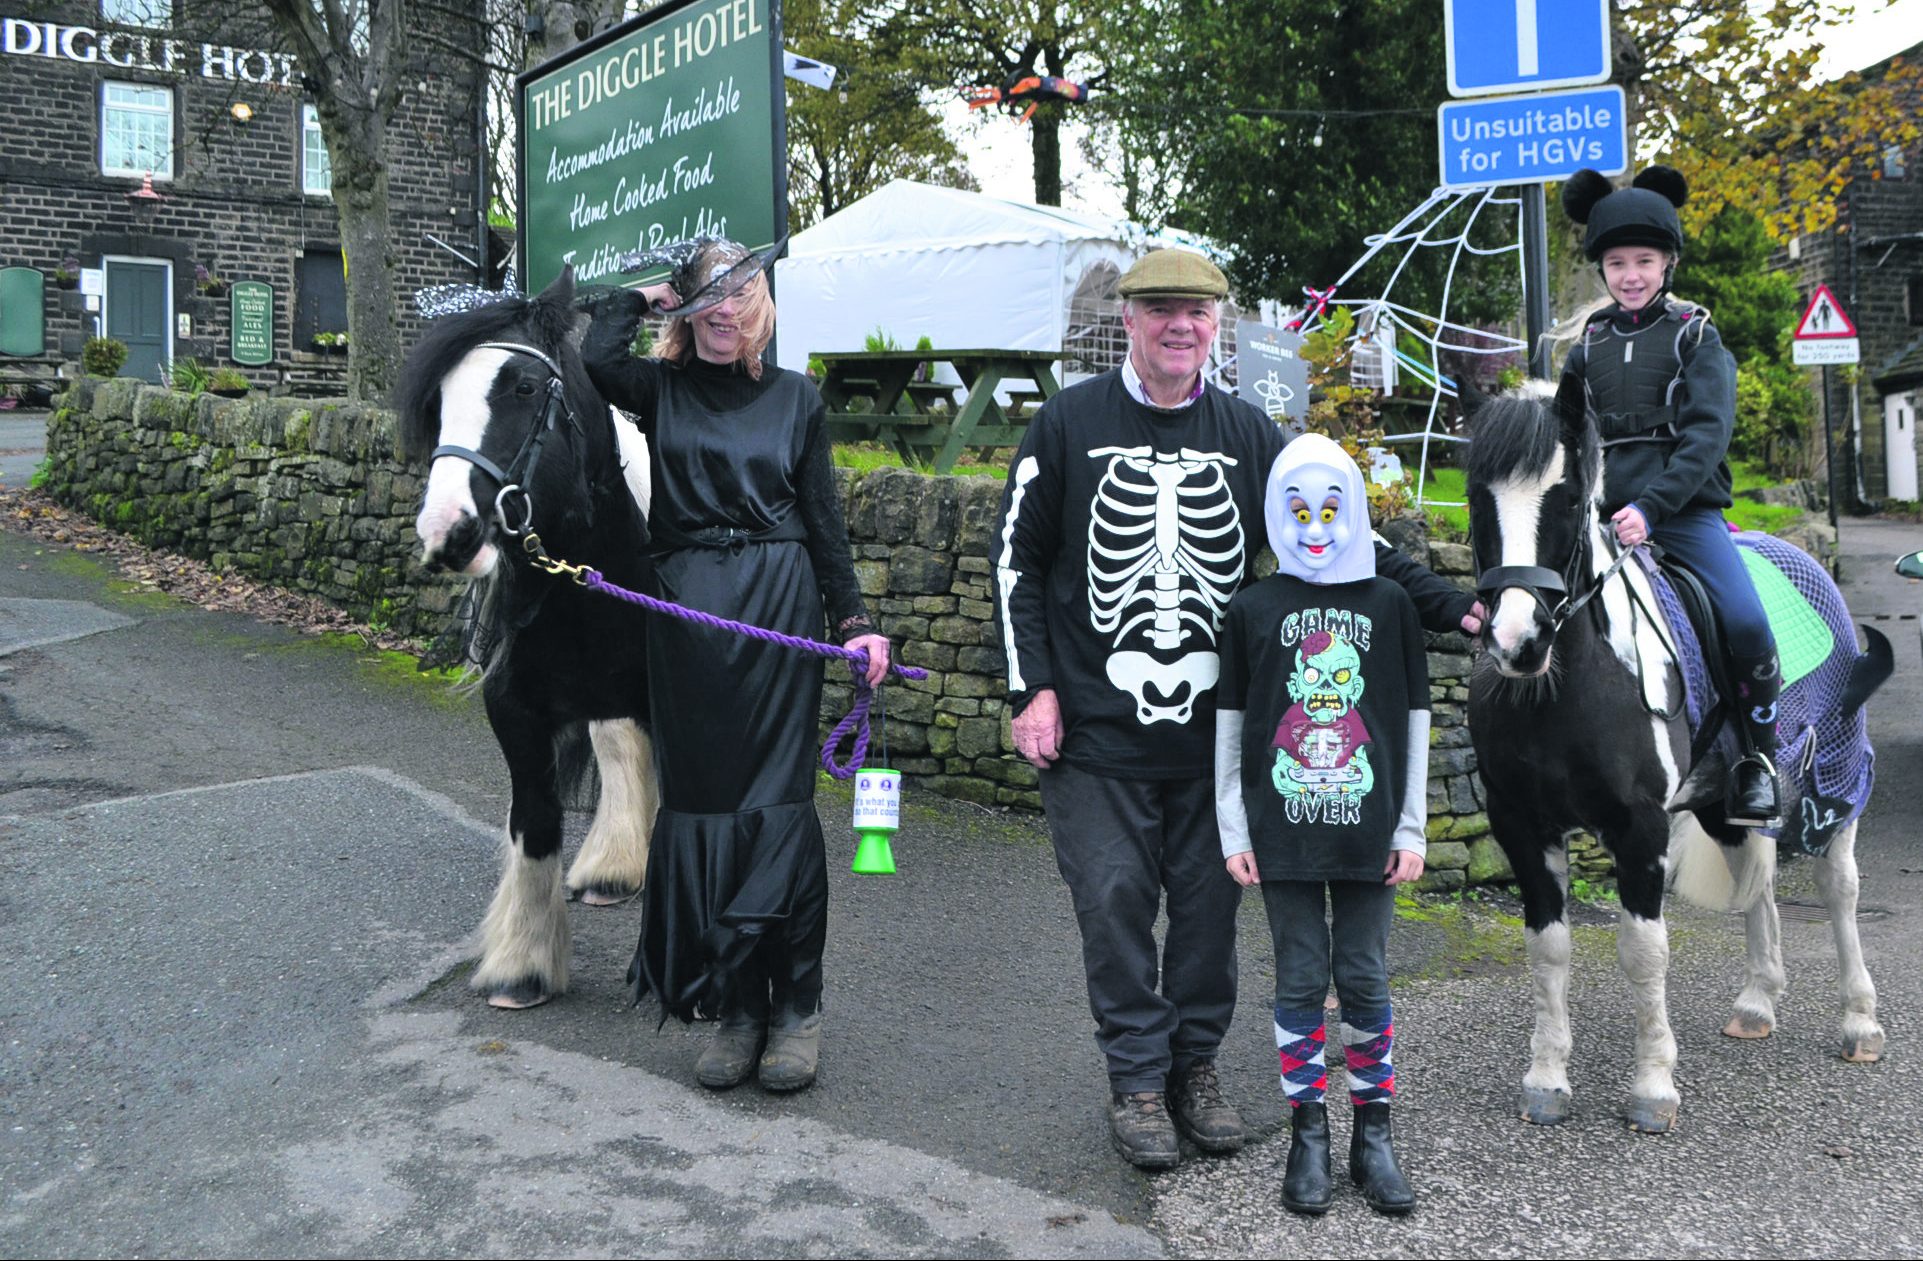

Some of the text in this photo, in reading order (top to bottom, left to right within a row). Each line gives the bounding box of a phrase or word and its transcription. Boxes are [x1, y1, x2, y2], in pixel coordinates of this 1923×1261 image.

[3, 18, 304, 86] DIGGLE HOT
[532, 0, 762, 130] THE DIGGLE HOTEL
[546, 76, 741, 184] Accommodation Available
[1451, 104, 1612, 142] Unsuitable
[1459, 136, 1603, 173] for HGVs
[570, 151, 714, 232] Home Cooked Food
[1281, 607, 1372, 651] GAME
[865, 797, 885, 806] what
[1285, 792, 1362, 825] OVER
